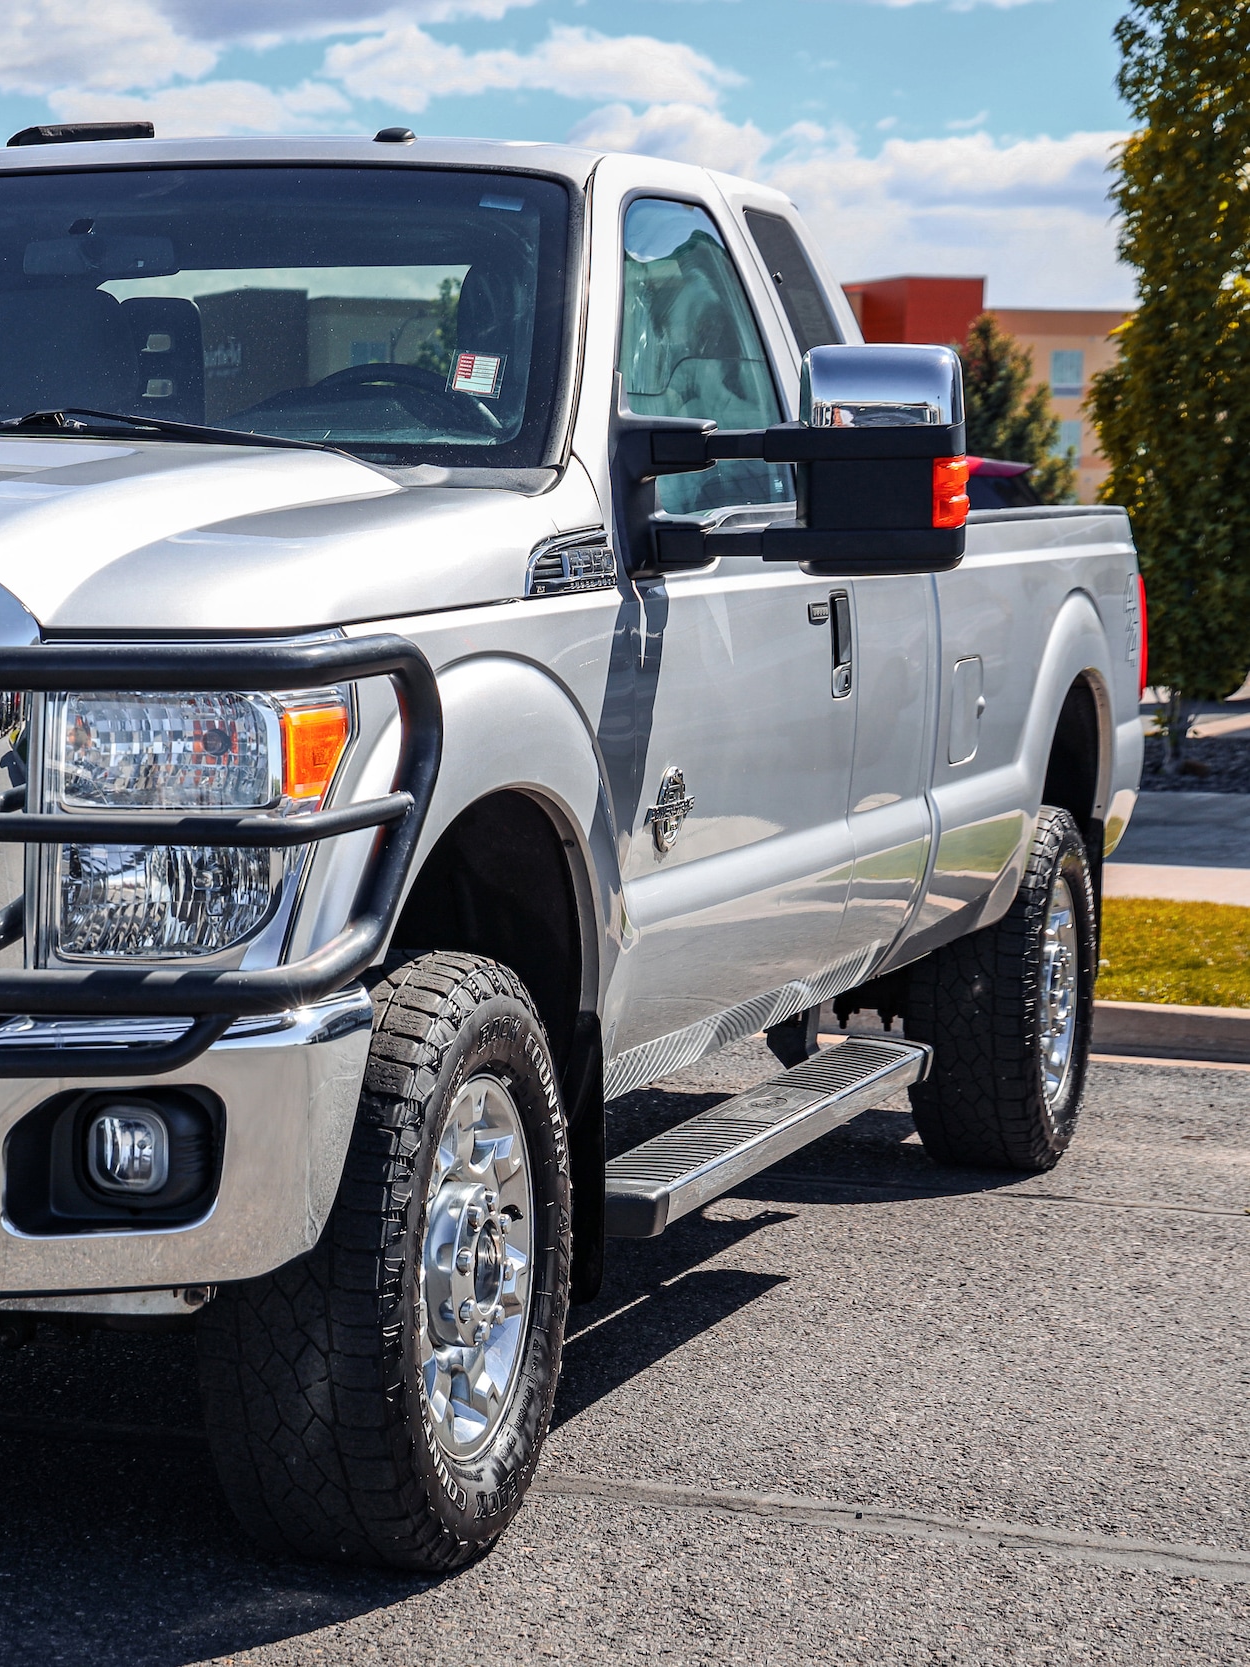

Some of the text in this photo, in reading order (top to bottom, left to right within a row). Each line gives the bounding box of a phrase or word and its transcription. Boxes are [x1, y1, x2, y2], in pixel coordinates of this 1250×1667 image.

[478, 1015, 523, 1054] BACK
[524, 1032, 569, 1178] COUNTRY
[416, 1363, 519, 1519] BACK COUNTRY
